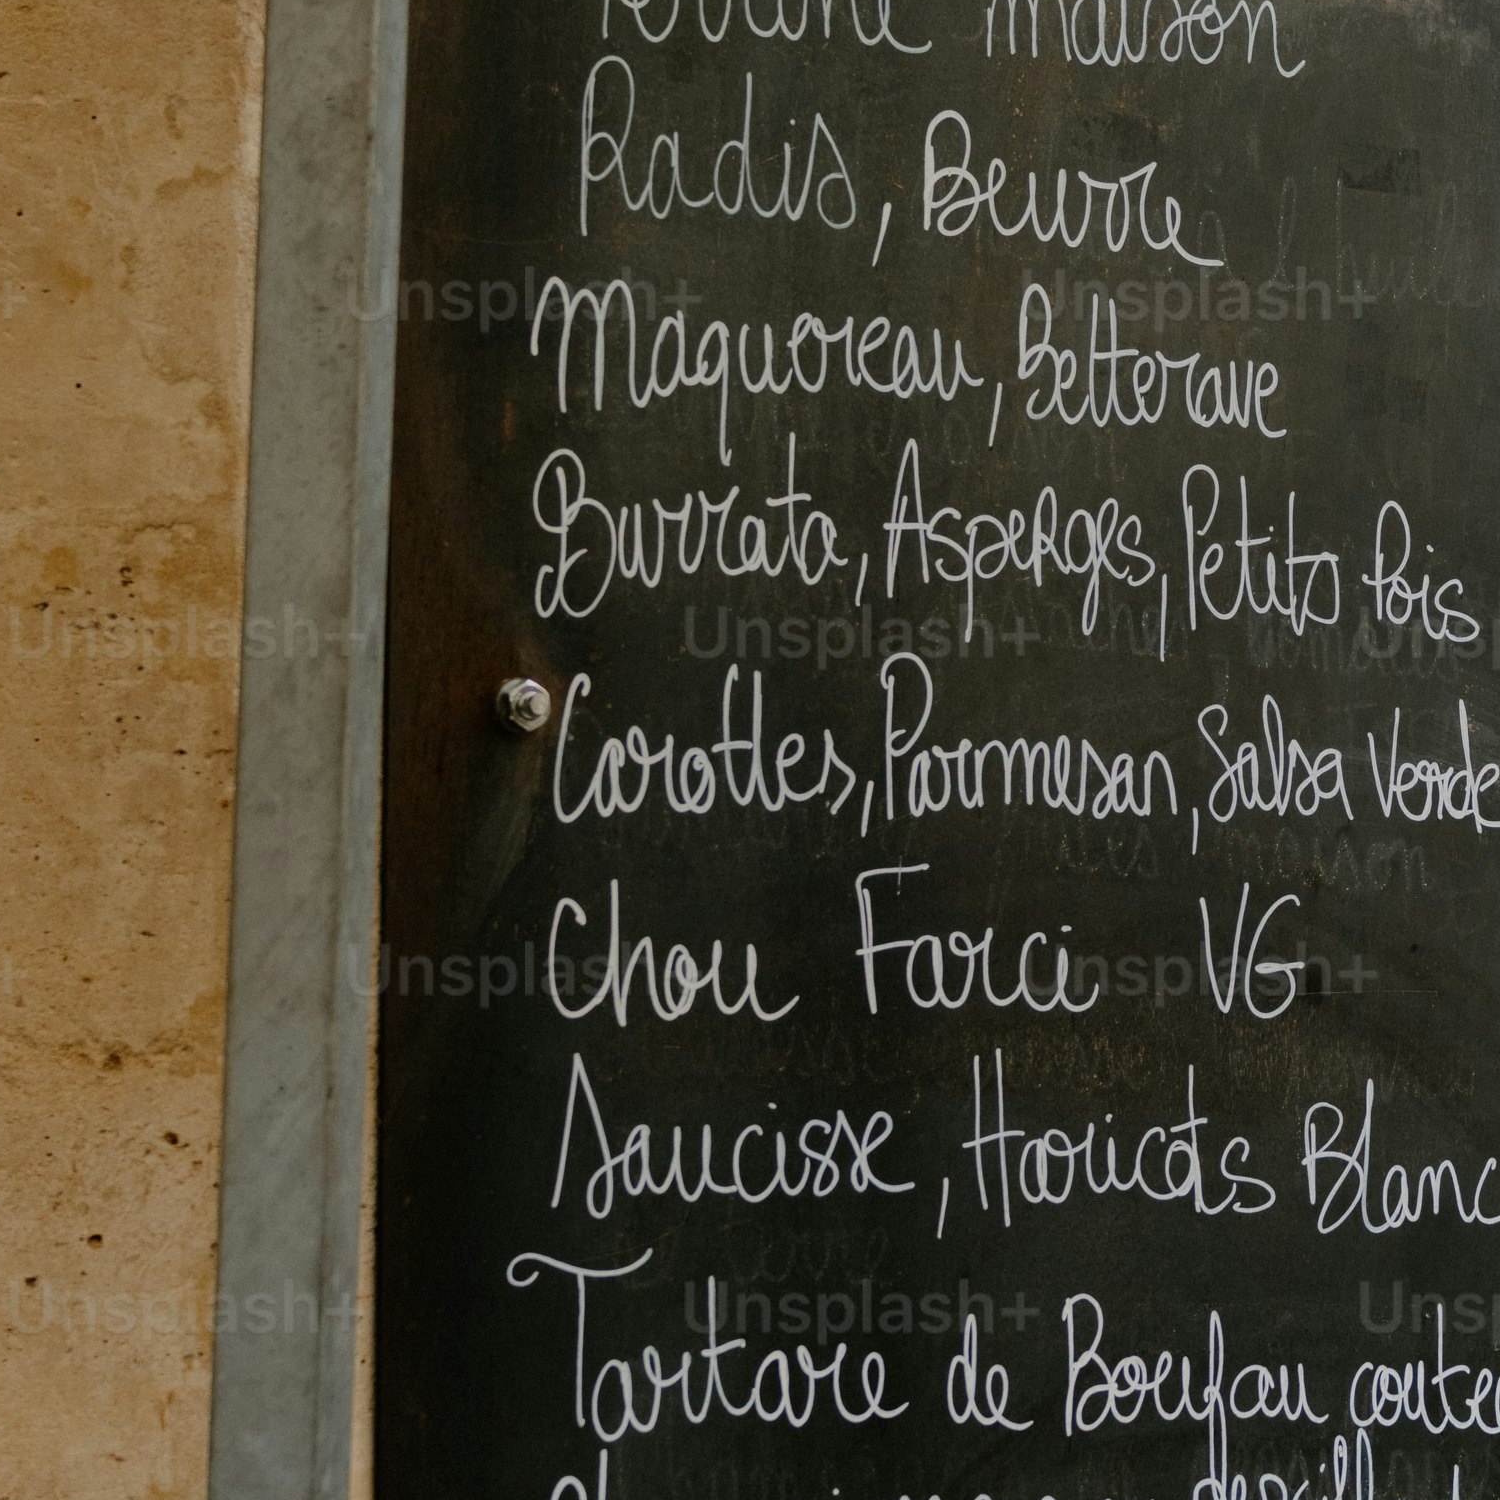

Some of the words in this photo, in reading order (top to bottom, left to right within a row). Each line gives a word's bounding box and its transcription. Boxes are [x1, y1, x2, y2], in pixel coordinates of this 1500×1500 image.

[579, 54, 892, 268] Radis,
[922, 108, 1225, 267] Beurre
[1018, 282, 1288, 438] Betterave
[532, 431, 869, 619] Burrata,
[1181, 463, 1340, 636] Petits
[1362, 499, 1481, 642] Pois
[1197, 694, 1355, 823] Salsa
[548, 877, 801, 1027] Chou
[855, 862, 1099, 1015] Farci
[1199, 881, 1306, 1019] VG
[962, 1047, 1277, 1228] Haricots
[505, 1247, 910, 1443] Tartare
[946, 1313, 1034, 1432] de
